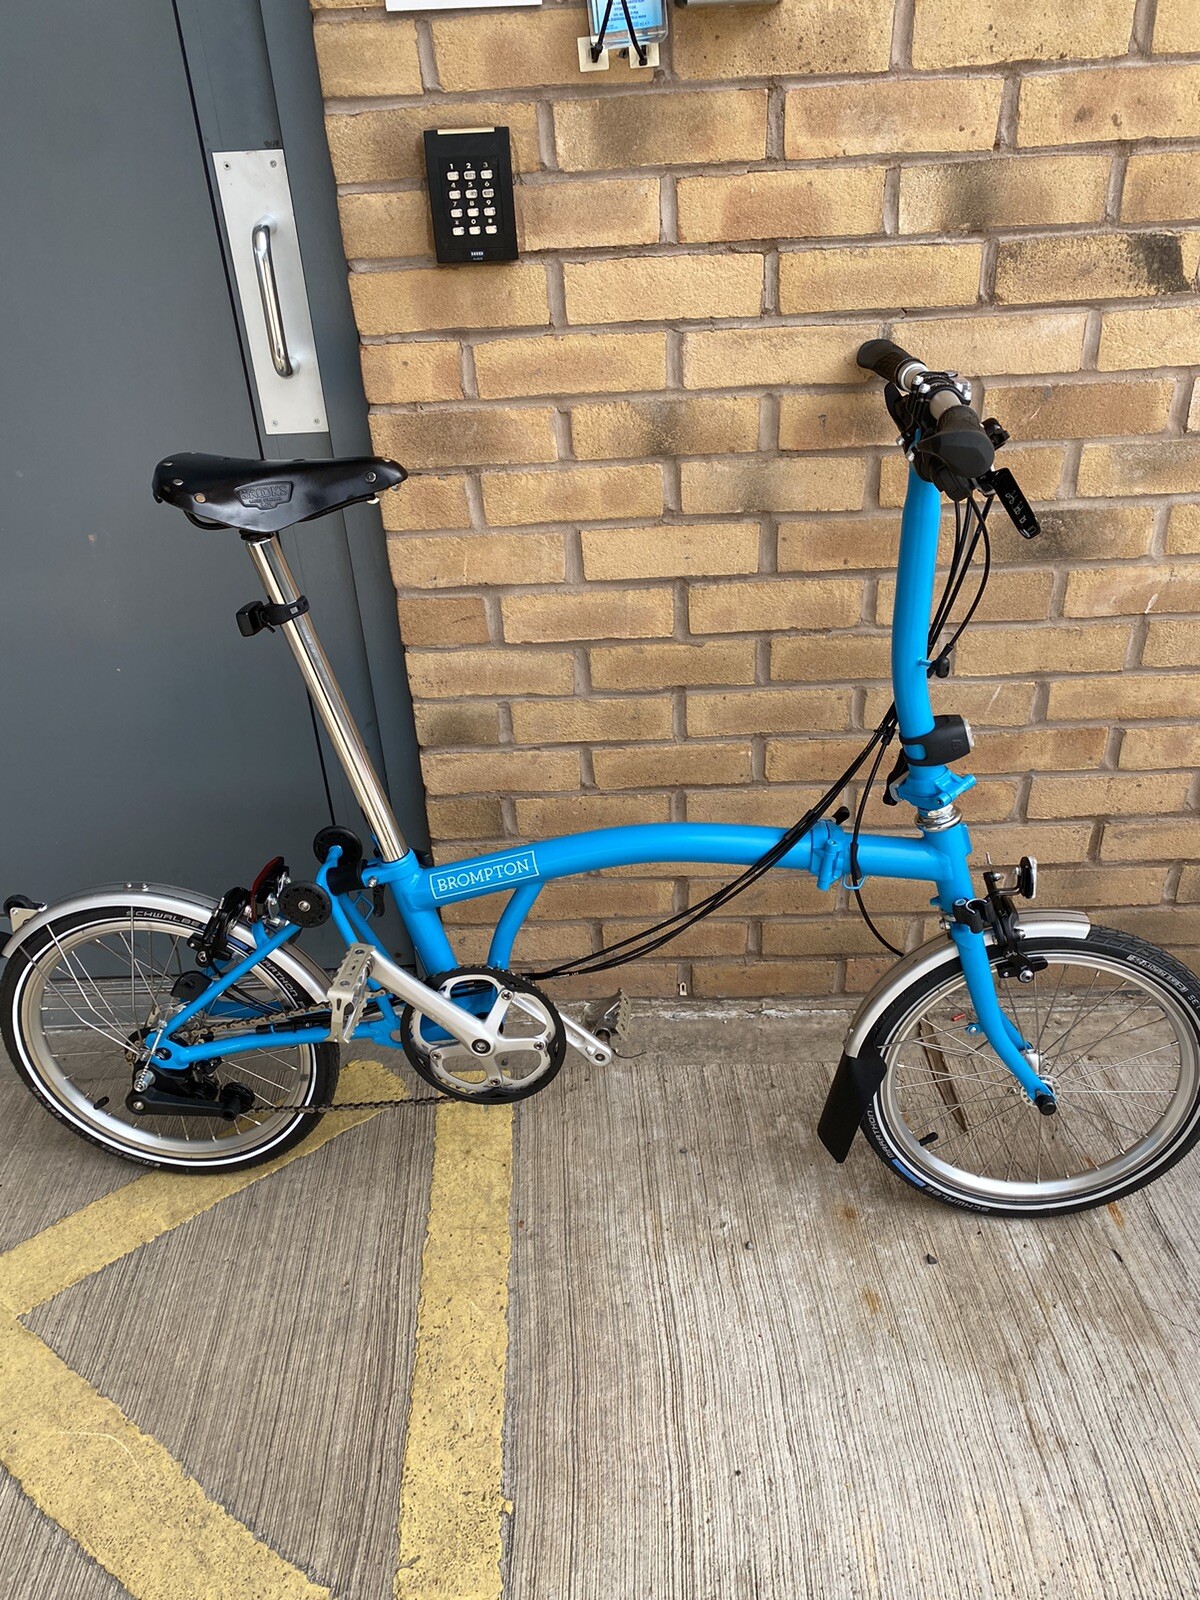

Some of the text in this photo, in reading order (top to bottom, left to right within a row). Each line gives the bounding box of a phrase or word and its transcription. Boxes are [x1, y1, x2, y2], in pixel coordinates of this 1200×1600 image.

[241, 485, 287, 500] BROOKS
[437, 859, 529, 892] BROMPTON
[867, 1110, 991, 1212] SCHWALBE MARATHON
